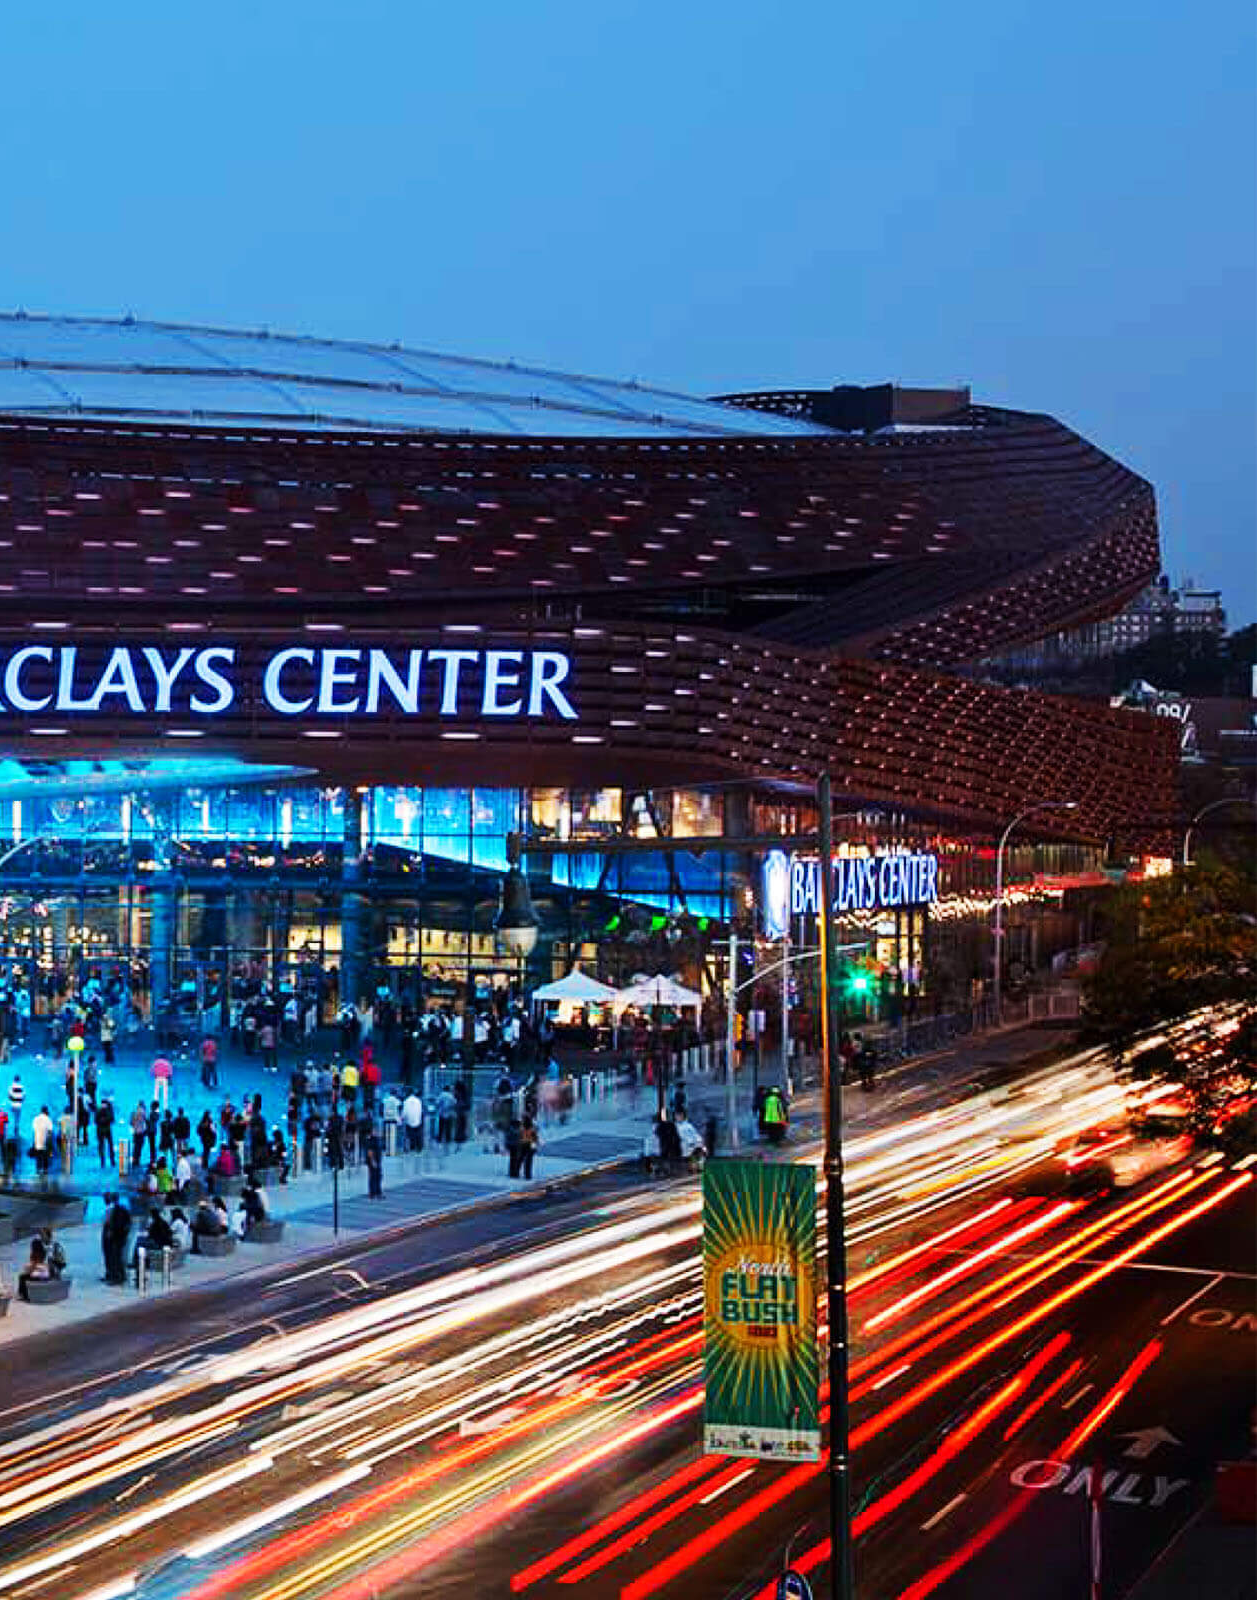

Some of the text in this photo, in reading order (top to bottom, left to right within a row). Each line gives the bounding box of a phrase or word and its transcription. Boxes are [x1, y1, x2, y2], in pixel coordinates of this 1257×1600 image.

[263, 648, 578, 719] CENTER
[792, 855, 938, 912] BALAYS CENTER
[723, 1272, 797, 1299] FLAT
[723, 1300, 798, 1325] BUSH
[1009, 1459, 1191, 1505] ONLY
